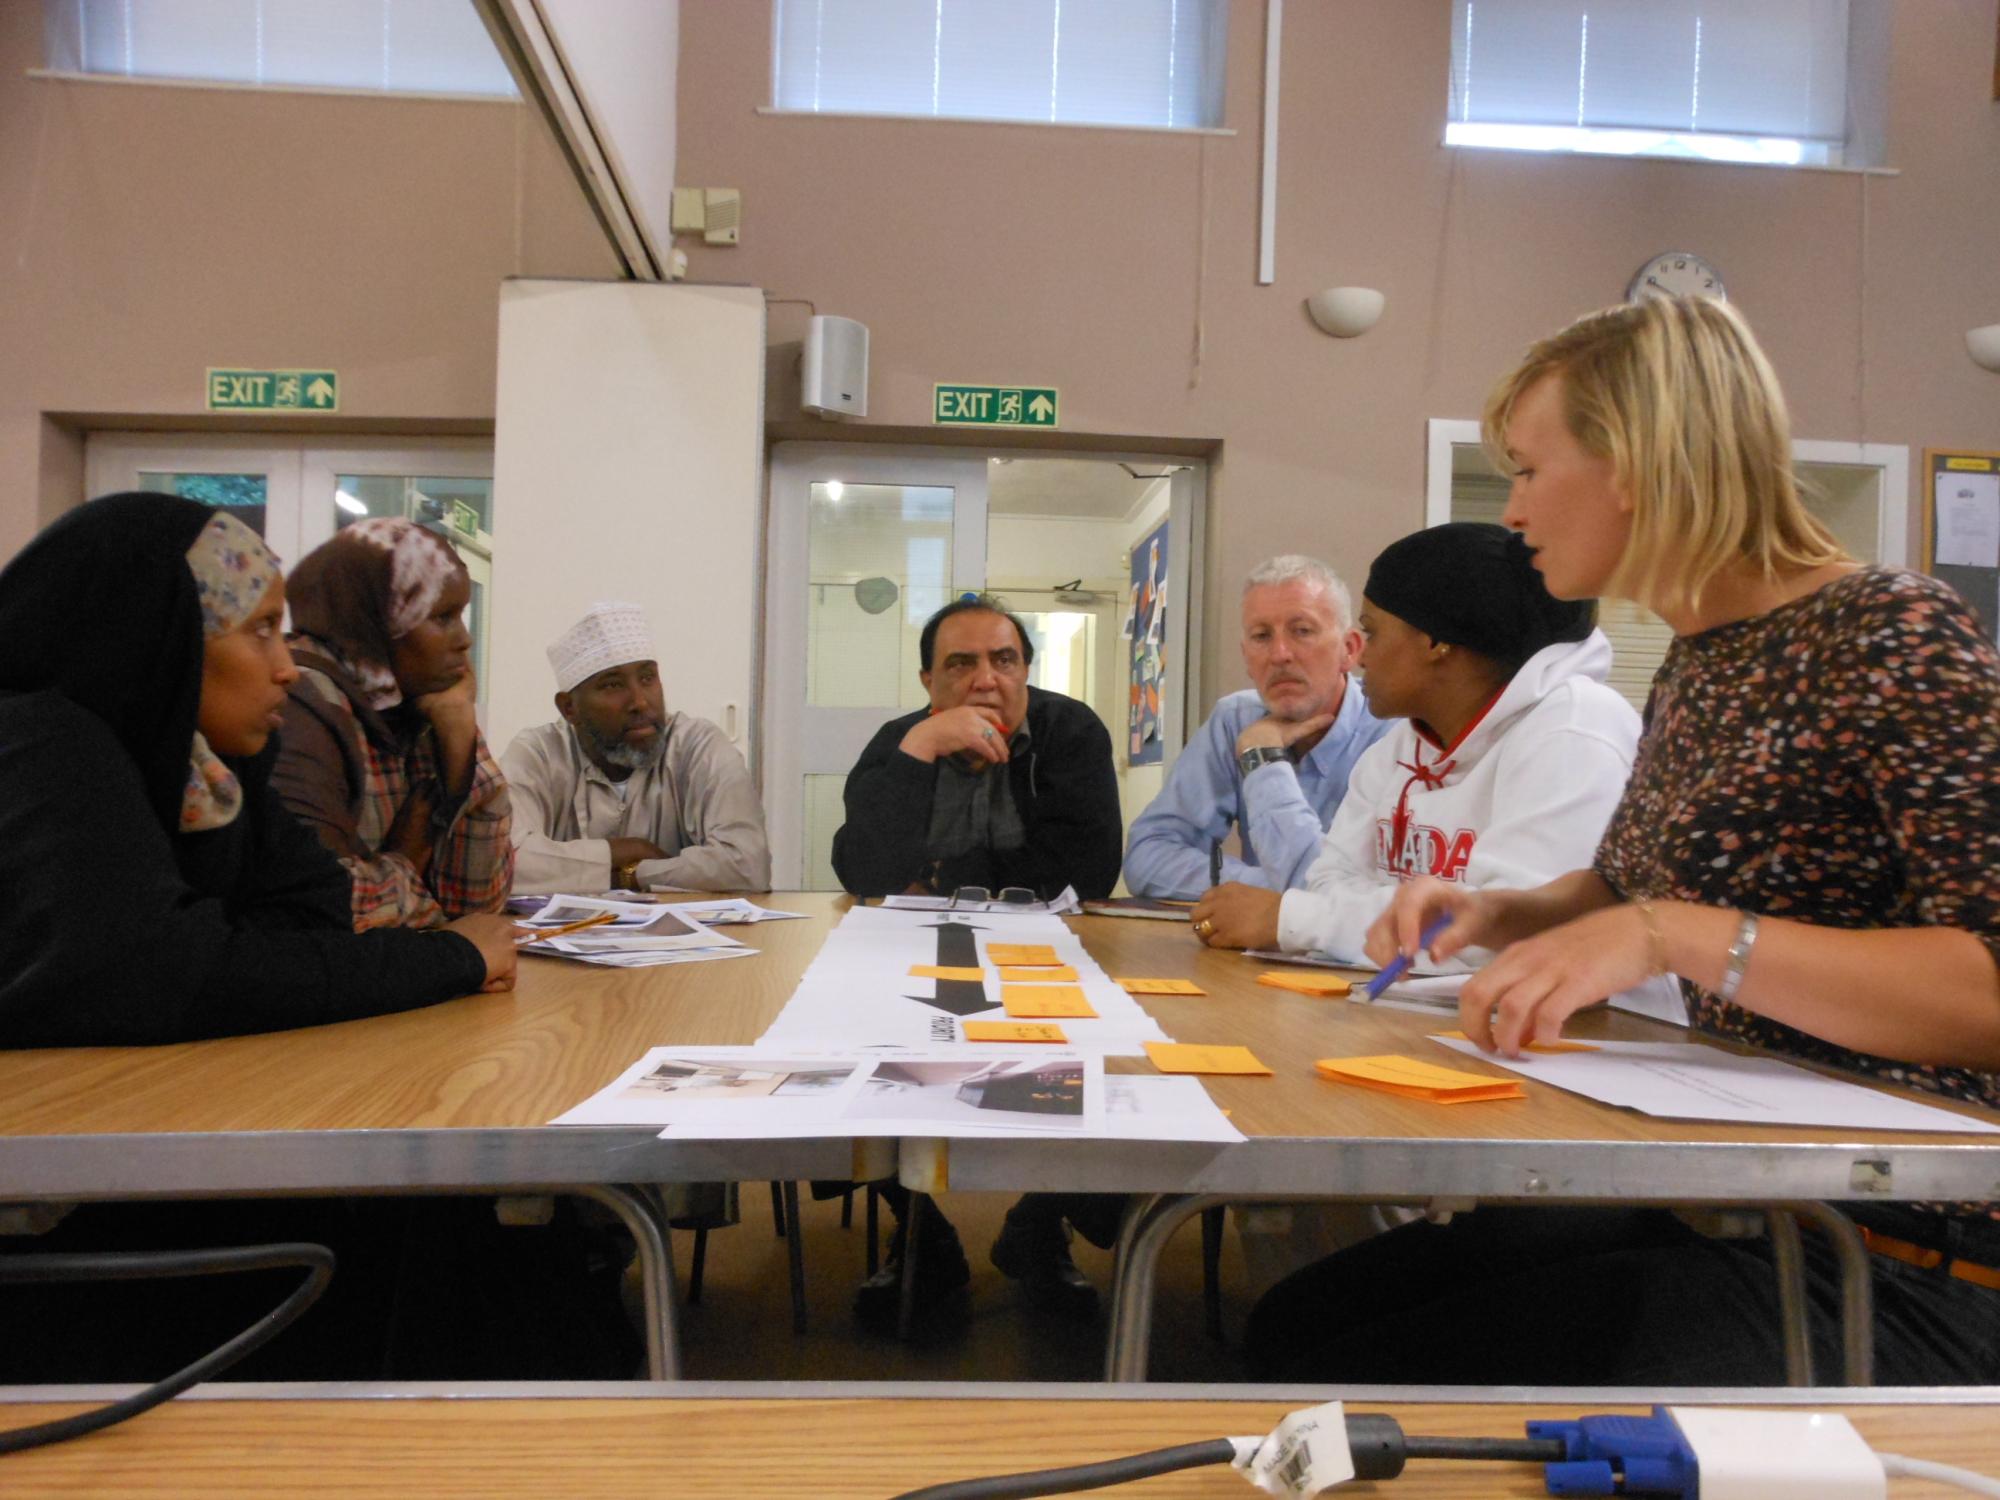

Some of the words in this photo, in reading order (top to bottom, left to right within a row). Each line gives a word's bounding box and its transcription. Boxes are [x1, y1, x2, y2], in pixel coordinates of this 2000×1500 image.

[1660, 264, 1668, 273] 11
[1674, 260, 1687, 270] 12
[1704, 279, 1713, 289] 2
[213, 375, 269, 403] EXIT
[938, 391, 992, 418] EXIT
[930, 1015, 956, 1043] PRIORITY
